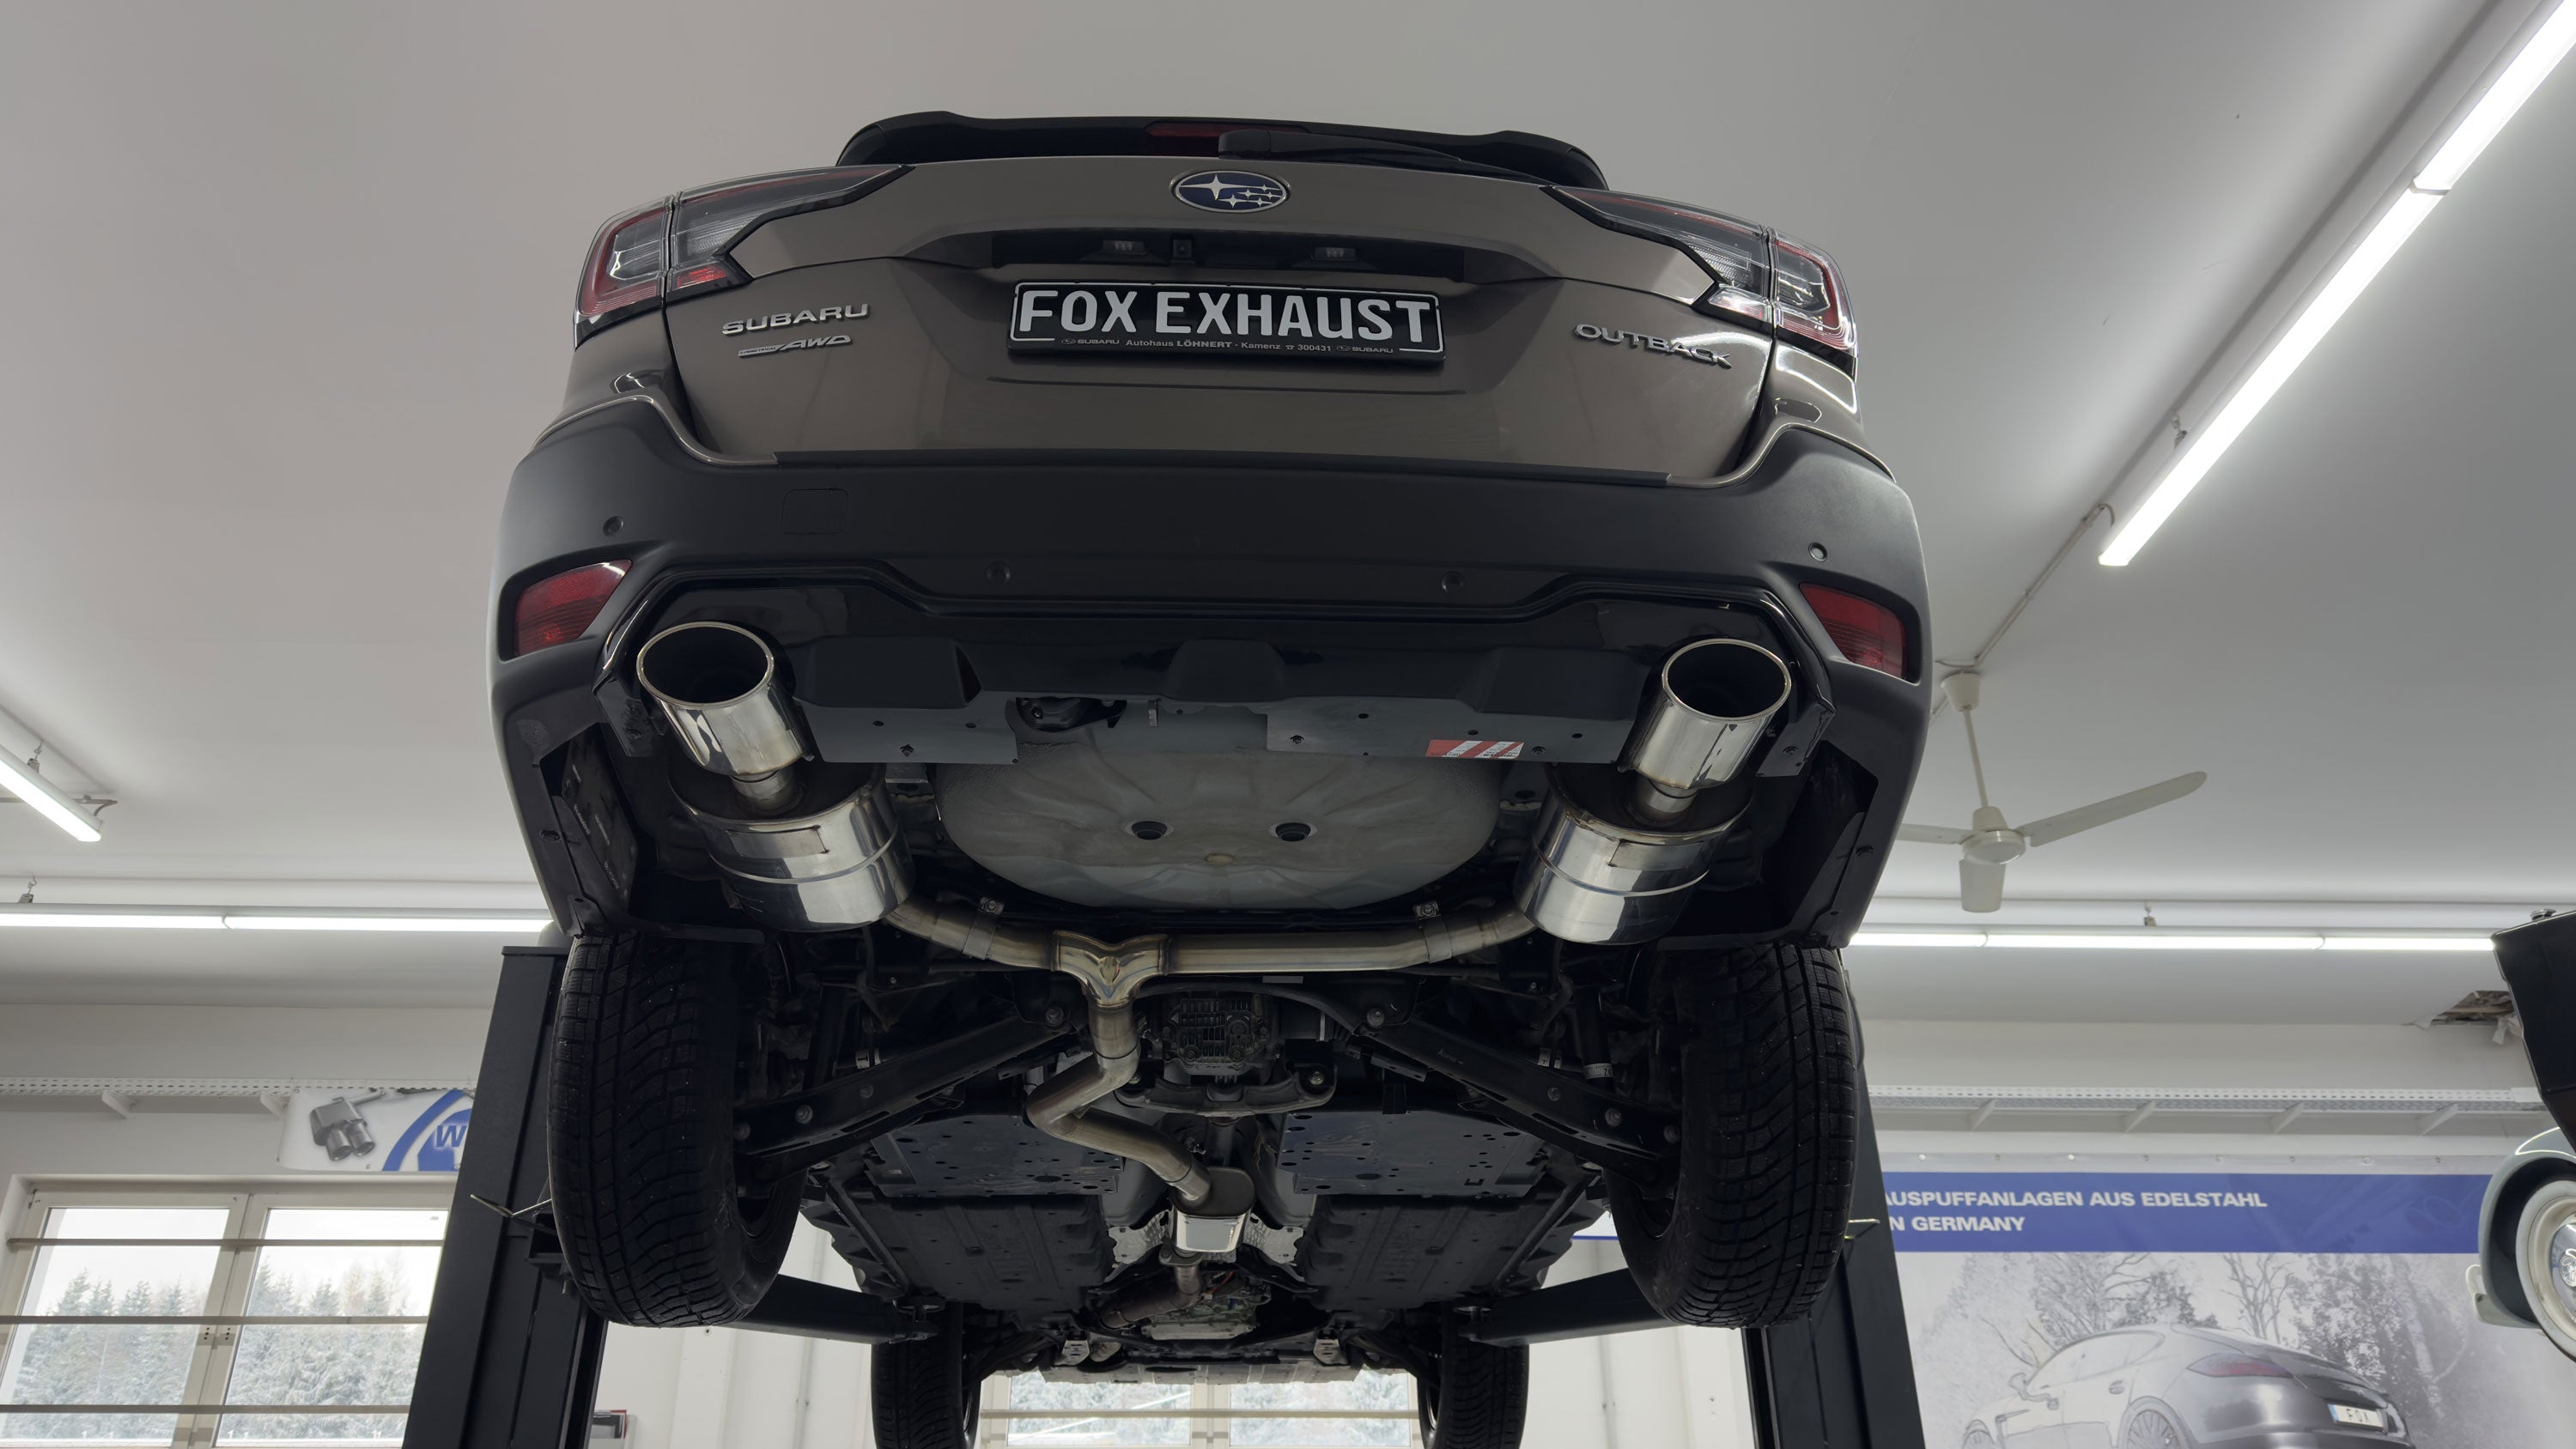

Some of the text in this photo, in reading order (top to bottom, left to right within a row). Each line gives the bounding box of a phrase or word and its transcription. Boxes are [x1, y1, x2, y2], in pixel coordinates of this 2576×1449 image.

[721, 303, 869, 336] SUBARU
[1018, 289, 1431, 343] FOX EXHAUST
[779, 335, 852, 351] AWD
[1126, 339, 1174, 348] Autohaus
[1176, 339, 1232, 349] LÖHNERT
[1241, 342, 1281, 350] Kamenz
[1573, 324, 1733, 369] OUTBACK
[2089, 1191, 2136, 1207] AUS
[2142, 1191, 2268, 1208] EDELSTAHL
[1888, 1216, 2026, 1232] N GERMANY
